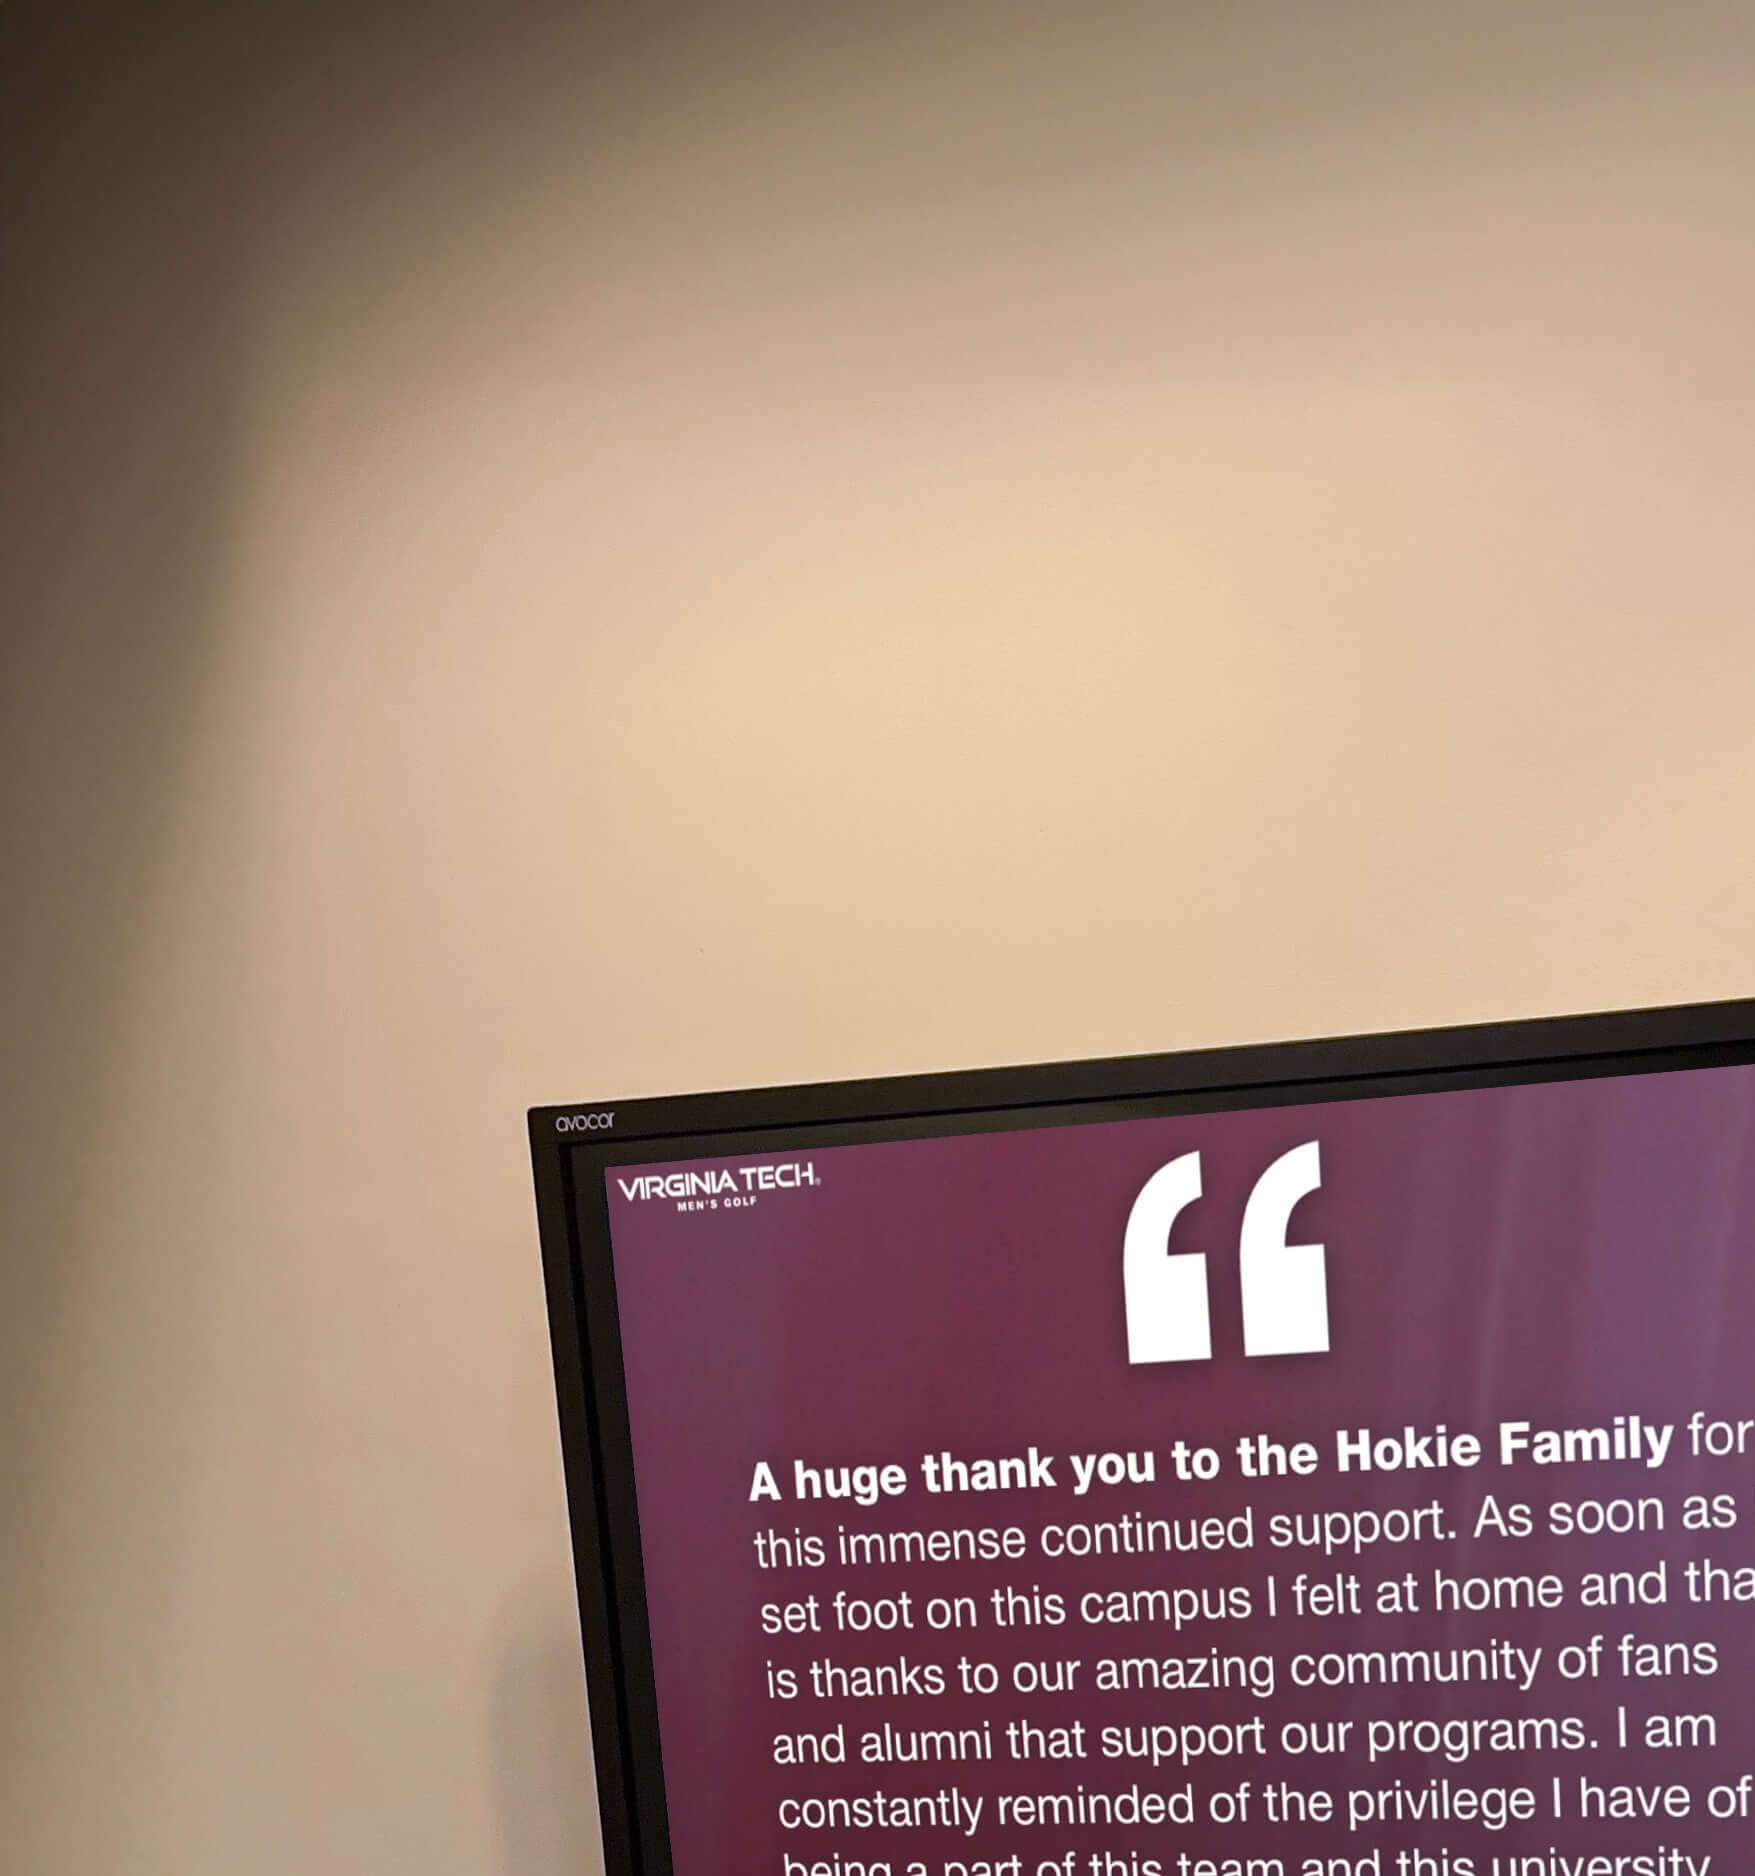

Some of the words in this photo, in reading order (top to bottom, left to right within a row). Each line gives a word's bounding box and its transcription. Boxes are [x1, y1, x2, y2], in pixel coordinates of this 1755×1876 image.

[556, 1112, 614, 1131] avocor
[618, 1170, 738, 1201] VIRGINIA
[677, 1198, 717, 1211] MEN'S
[724, 1196, 756, 1207] GOLF
[750, 1462, 781, 1501] A
[795, 1460, 906, 1505] huge
[921, 1447, 1056, 1492] thank
[1070, 1452, 1154, 1494] you
[1172, 1442, 1219, 1480] to
[1237, 1435, 1318, 1476] the
[1337, 1425, 1480, 1472] Hokie
[1500, 1416, 1674, 1467] Family
[1688, 1412, 1754, 1455] for
[754, 1528, 825, 1568] this
[839, 1526, 1025, 1564] immense
[1042, 1507, 1253, 1556] continued
[1270, 1501, 1455, 1555] support.
[1474, 1496, 1532, 1537] As
[1550, 1498, 1663, 1534] soon
[1683, 1495, 1736, 1529] as
[762, 1596, 820, 1633] set
[833, 1591, 913, 1630] foot
[927, 1598, 976, 1628] on
[991, 1586, 1065, 1626] this
[1081, 1587, 1251, 1630] campus
[1268, 1576, 1275, 1616] I
[1292, 1574, 1361, 1615] felt
[1377, 1573, 1419, 1613] at
[1435, 1570, 1562, 1610] home
[1581, 1561, 1666, 1605] and
[767, 1661, 797, 1698] is
[810, 1656, 945, 1697] thanks
[958, 1657, 998, 1693] to
[1014, 1661, 1080, 1692] our
[1097, 1648, 1274, 1697] amazing
[1291, 1639, 1541, 1690] community
[1559, 1635, 1603, 1678] of
[1618, 1634, 1717, 1676] fans
[774, 1724, 845, 1763] and
[862, 1721, 991, 1762] alumni
[1006, 1720, 1086, 1758] that
[1102, 1717, 1266, 1766] support
[1282, 1722, 1353, 1753] our
[1369, 1718, 1597, 1762] programs.
[1619, 1707, 1626, 1747] I
[1646, 1715, 1715, 1747] am
[779, 1788, 983, 1835] constantly
[999, 1784, 1193, 1825] reminded
[1210, 1782, 1250, 1822] of
[1263, 1782, 1332, 1821] the
[1349, 1780, 1535, 1830] privilege
[1554, 1778, 1560, 1817] I
[1581, 1777, 1690, 1817] have
[1708, 1775, 1752, 1817] of
